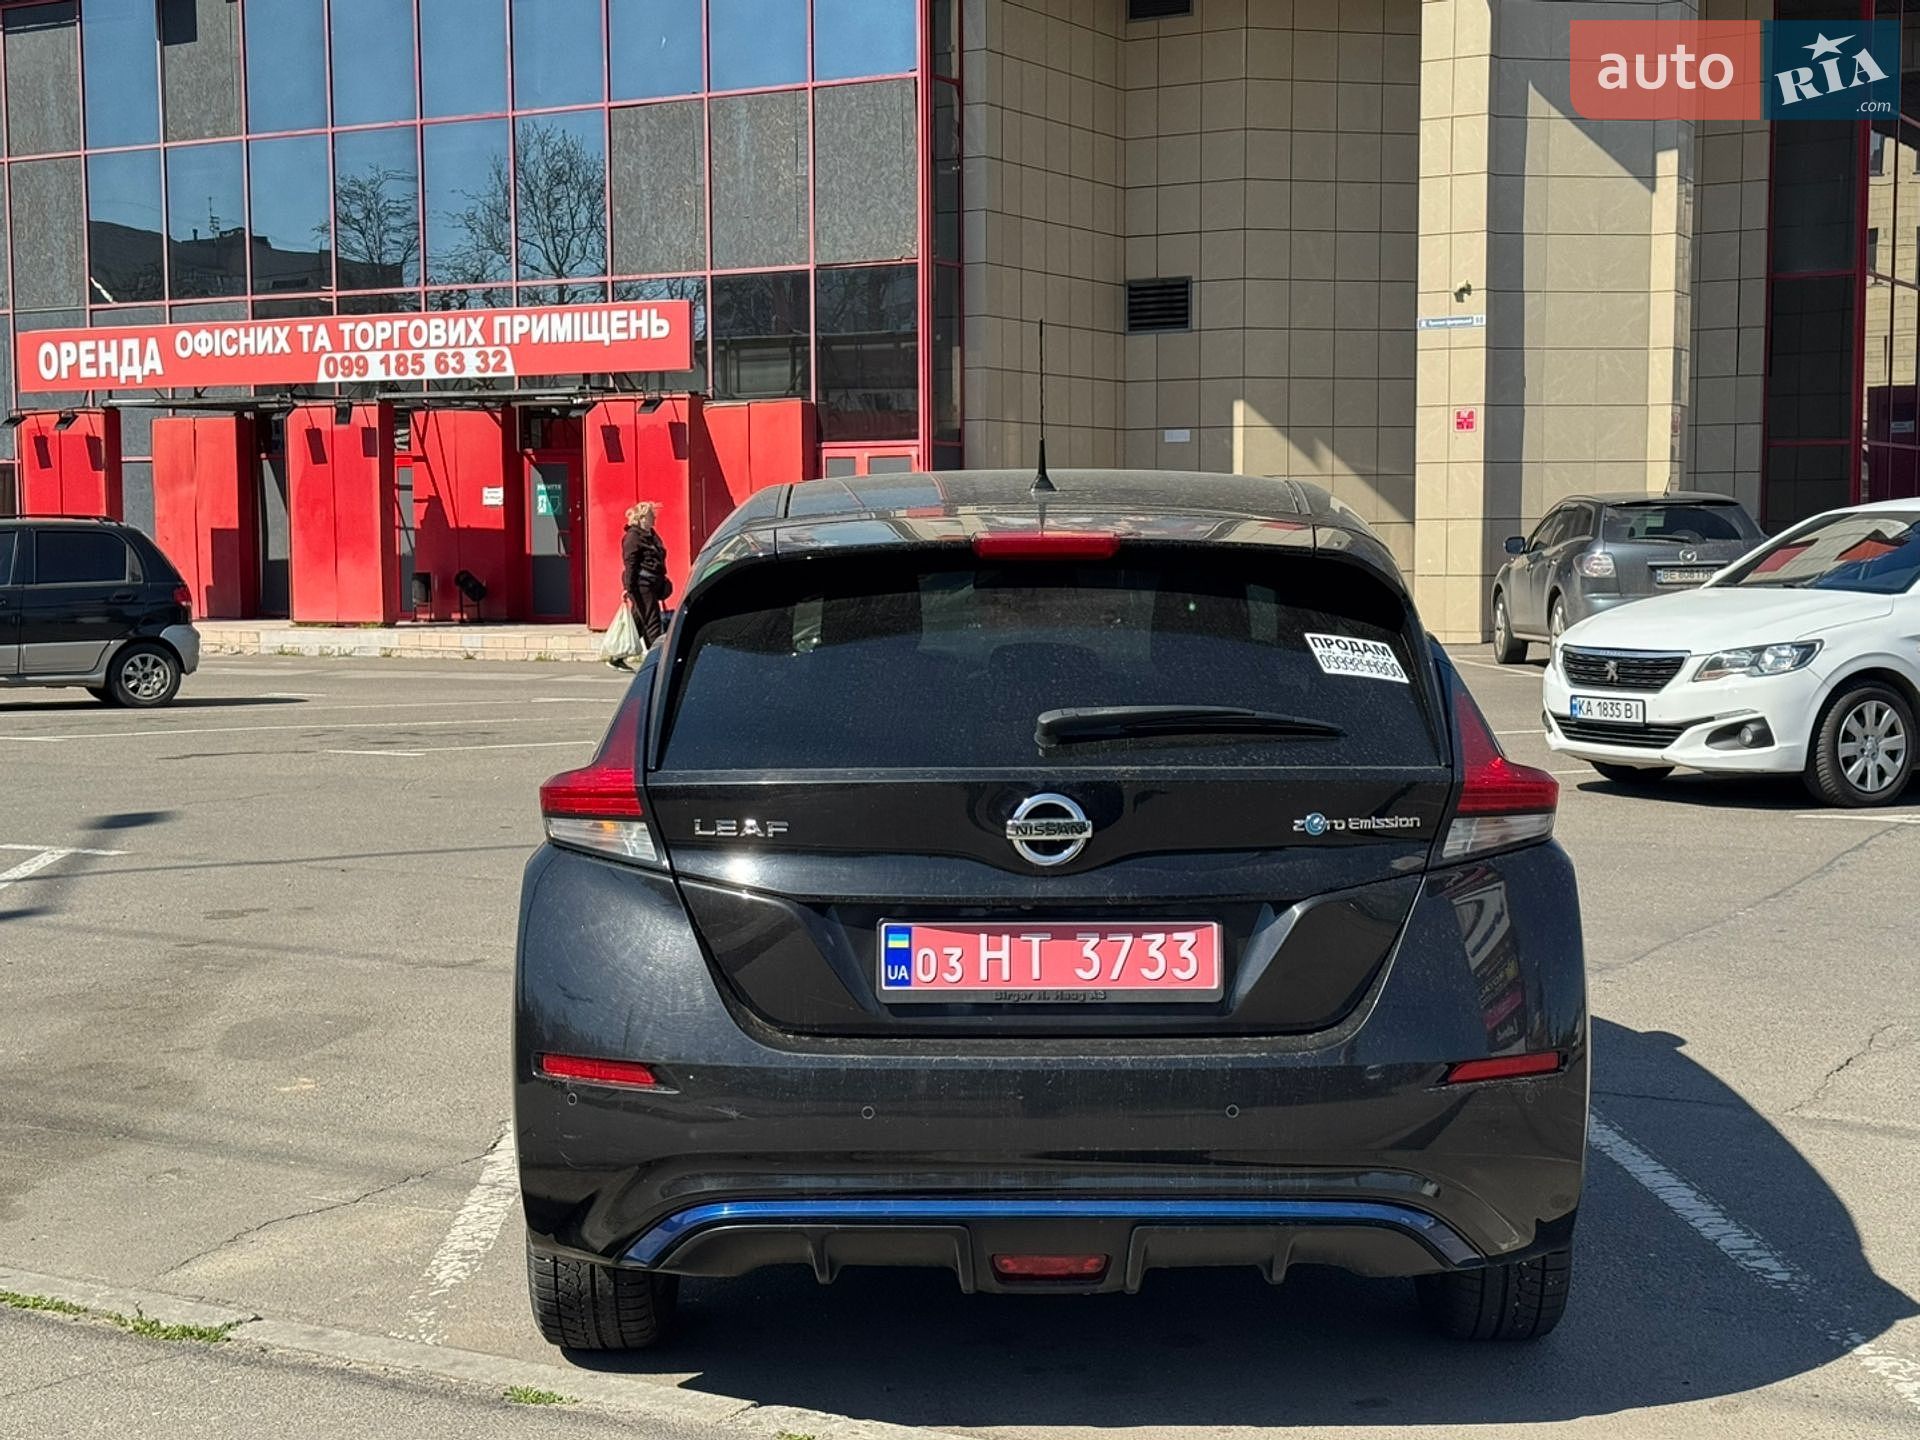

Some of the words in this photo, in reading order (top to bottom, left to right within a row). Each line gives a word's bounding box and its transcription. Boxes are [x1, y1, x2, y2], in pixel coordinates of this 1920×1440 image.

[38, 336, 163, 384] ОРЕНДА
[174, 326, 291, 358] ОФІСНИХ
[297, 323, 332, 353] ТА
[339, 313, 486, 350] ТОРГОВИХ
[493, 308, 671, 346] ПРИМІЩЕНЬ
[324, 355, 369, 378] 099
[379, 353, 425, 376] 185
[434, 351, 466, 375] 63
[475, 350, 507, 374] 32
[1310, 637, 1392, 657] ПРОДАМ
[1578, 700, 1593, 716] KA
[1598, 702, 1622, 718] 1835
[1625, 703, 1639, 719] BI
[694, 819, 789, 837] LEAF
[1016, 822, 1087, 836] NISSAN
[1348, 816, 1420, 830] Emission
[916, 947, 964, 983] 03
[978, 933, 1051, 981] HT
[1073, 932, 1199, 981] 3733
[887, 965, 909, 980] UA
